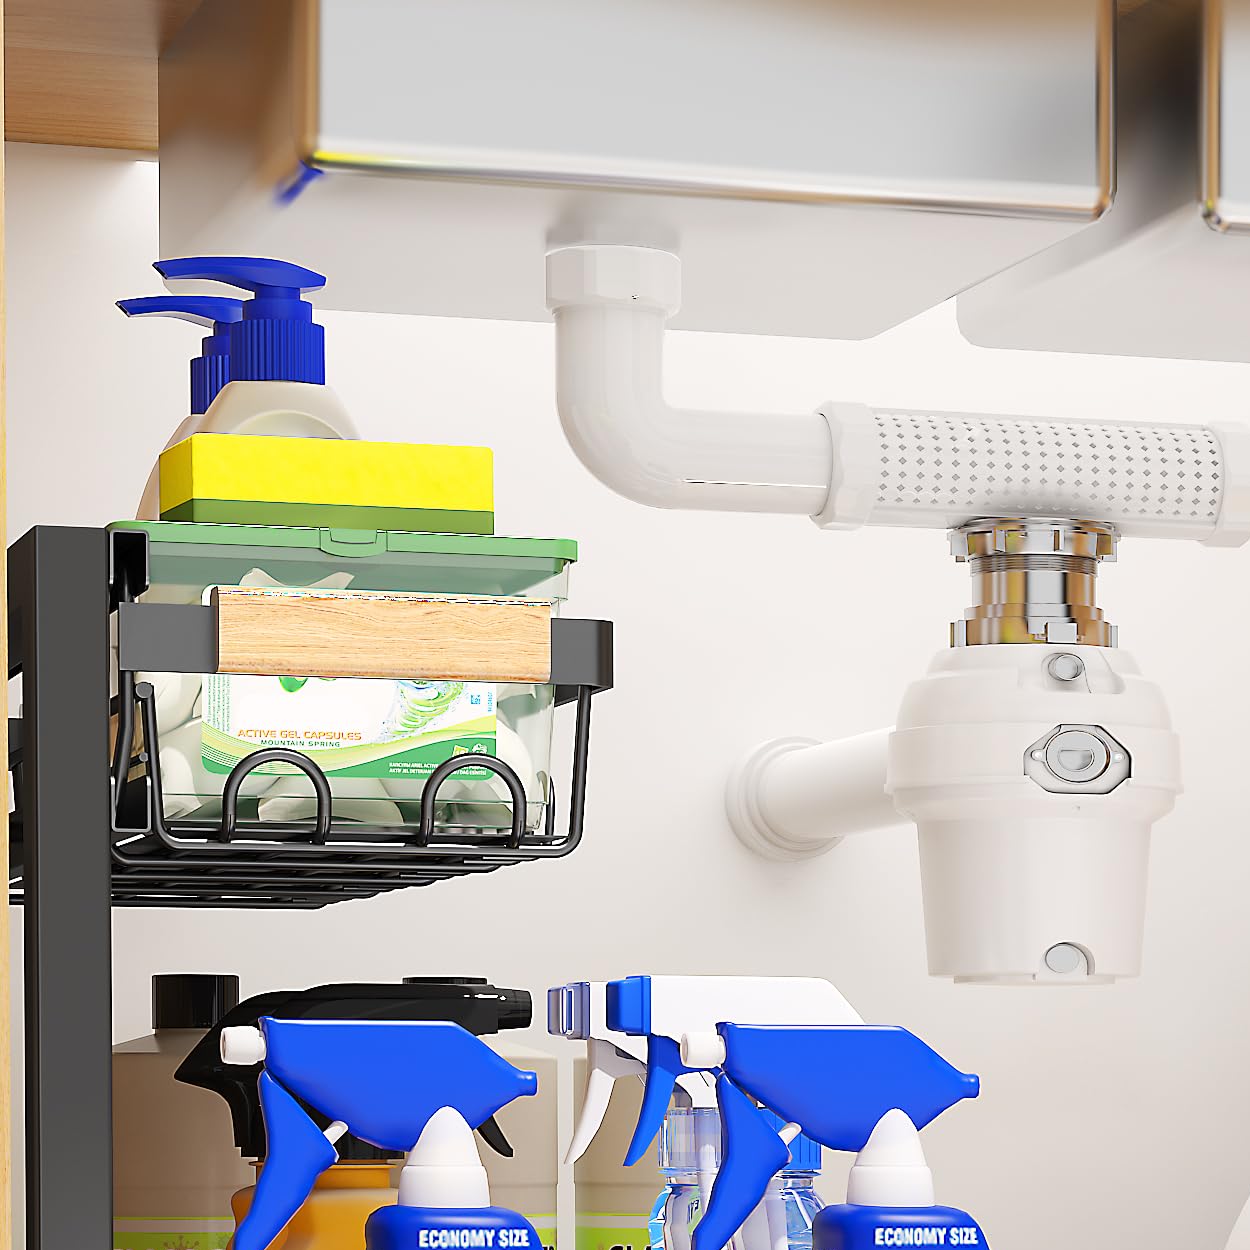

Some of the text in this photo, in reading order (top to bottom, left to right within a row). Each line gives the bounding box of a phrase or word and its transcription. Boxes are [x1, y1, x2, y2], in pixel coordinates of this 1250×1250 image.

[237, 729, 362, 741] ACTIVE GEL CAPSULES
[260, 739, 305, 747] MOUNTAIN
[418, 1228, 531, 1249] ECONOMY SIZE
[874, 1227, 979, 1246] ECONOMY SIZE
